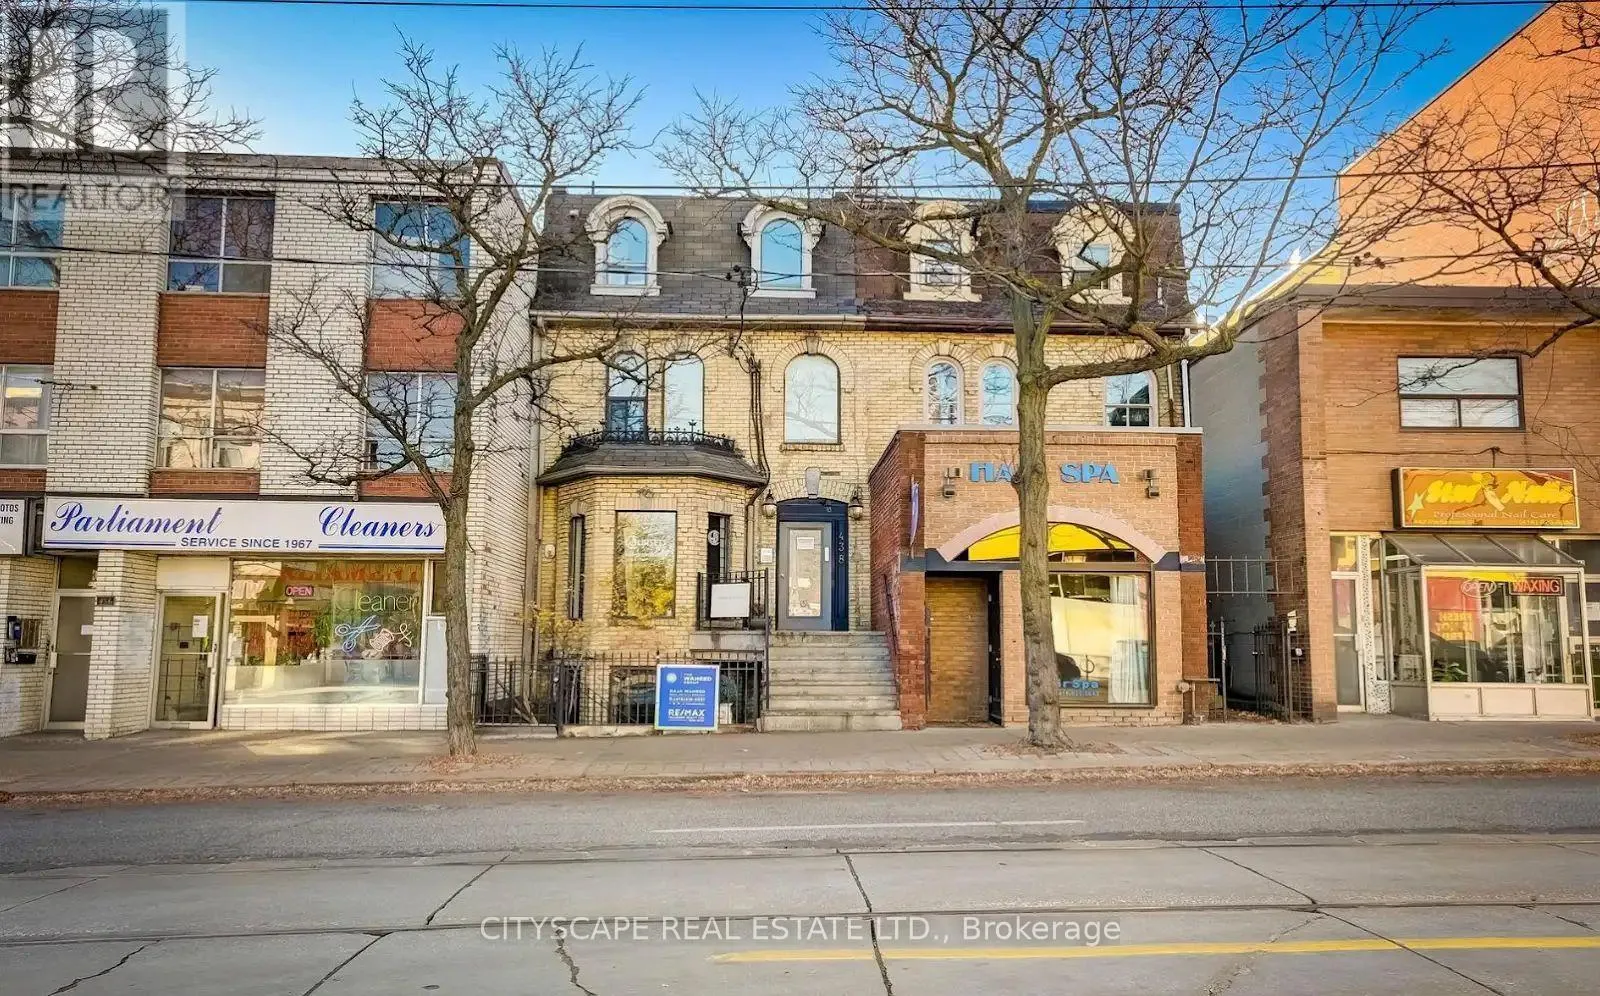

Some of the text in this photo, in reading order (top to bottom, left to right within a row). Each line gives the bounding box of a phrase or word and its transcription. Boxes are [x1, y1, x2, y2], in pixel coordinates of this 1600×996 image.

[1060, 462, 1120, 485] SPA
[51, 501, 439, 538] Parliament Cleaners
[180, 537, 313, 549] SERVICE SINCE 1967
[286, 586, 313, 596] OPEN
[1463, 583, 1494, 593] OPEN
[1512, 579, 1560, 593] WAXING
[668, 709, 705, 717] RE/MAX
